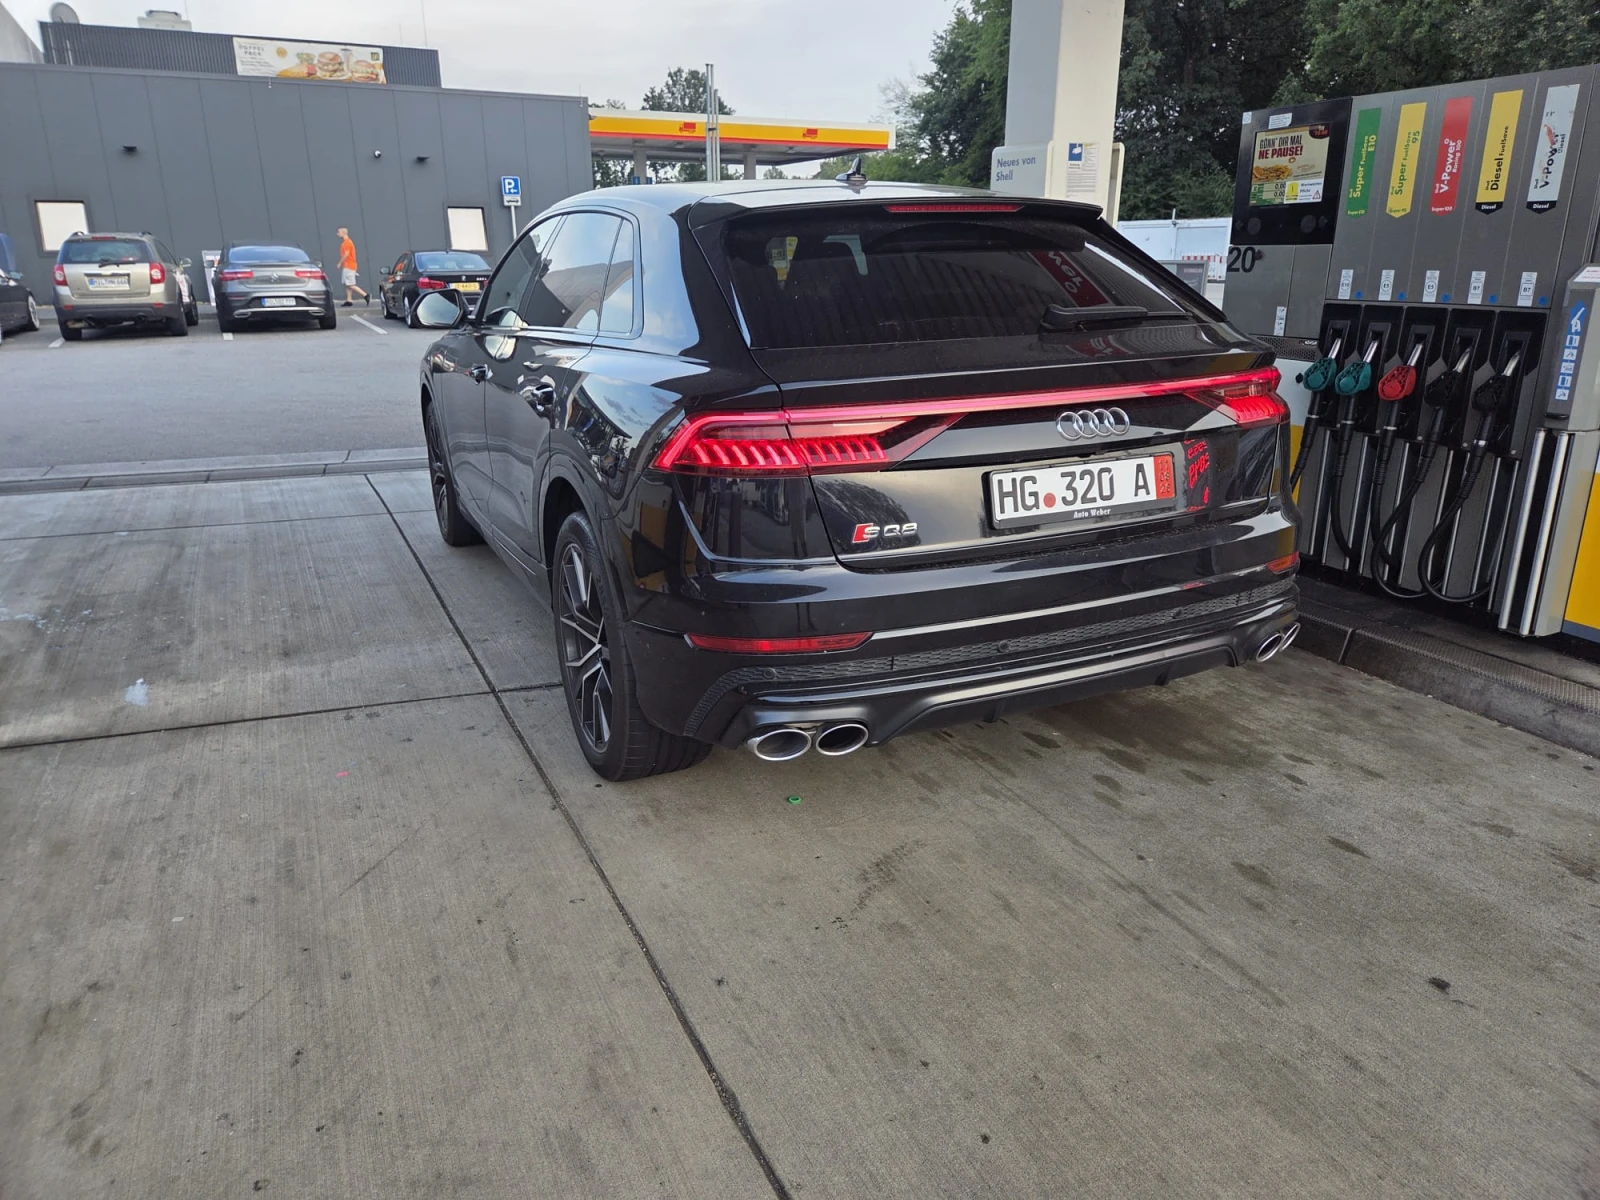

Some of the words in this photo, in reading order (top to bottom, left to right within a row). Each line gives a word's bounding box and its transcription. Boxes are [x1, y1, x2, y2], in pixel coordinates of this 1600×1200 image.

[1278, 136, 1289, 147] DIR
[1290, 134, 1302, 145] MAL
[1368, 135, 1376, 152] E10
[1411, 130, 1420, 143] 95
[1258, 149, 1269, 160] NE
[1271, 145, 1303, 159] PAUSE!
[1490, 158, 1504, 190] Diesel
[1499, 125, 1509, 156] FuelSave
[996, 158, 1020, 169] Neues
[1021, 157, 1036, 166] von
[1353, 166, 1365, 197] Super
[1360, 136, 1368, 164] FuelSave
[1395, 164, 1406, 195] Super
[1402, 131, 1411, 160] FuelSave
[1439, 141, 1456, 193] V-Power
[1452, 152, 1461, 173] Racing
[996, 170, 1014, 181] Shell
[505, 179, 515, 194] P
[1227, 246, 1256, 273] 20
[997, 474, 1040, 514] HG
[1060, 467, 1115, 507] 320
[1134, 463, 1151, 497] A
[1074, 511, 1089, 519] Auto
[1090, 508, 1111, 517] Weber
